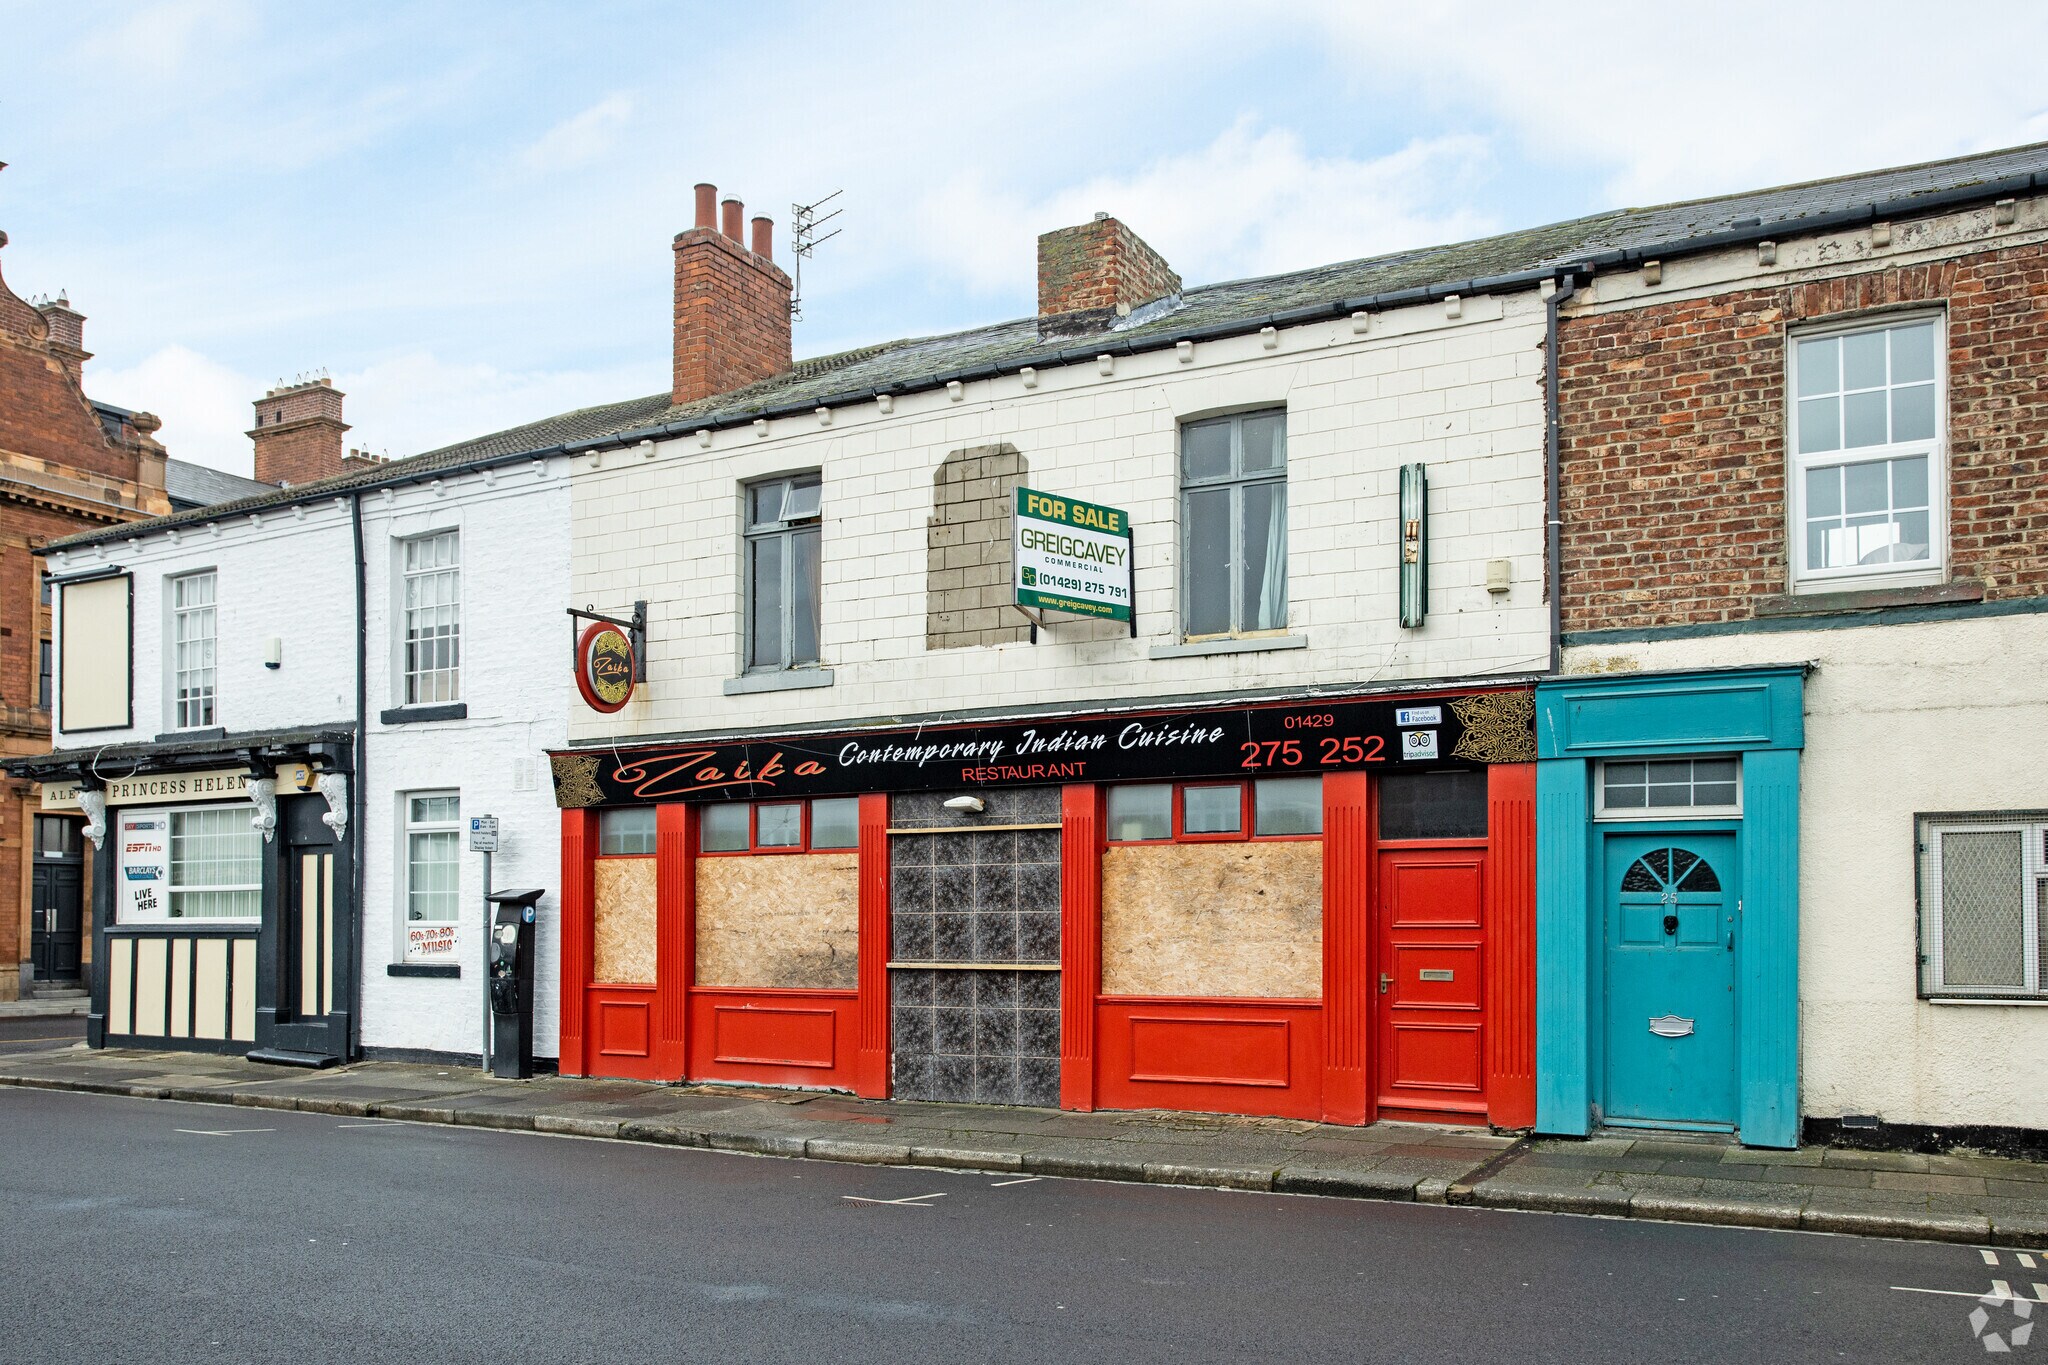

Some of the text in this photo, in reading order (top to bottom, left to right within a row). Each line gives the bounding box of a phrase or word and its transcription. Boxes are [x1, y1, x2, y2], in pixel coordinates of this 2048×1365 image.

[1028, 494, 1119, 532] FOR SALE
[1044, 556, 1104, 574] COMMERCIAL
[1039, 572, 1127, 599] (01429) 275 791
[1038, 595, 1113, 614] www.greigcavey.com
[593, 657, 629, 676] Zaika
[1284, 713, 1334, 729] 01429
[838, 722, 1225, 768] Contemporary Indian Cuisine
[1240, 735, 1386, 768] 275 252
[1403, 750, 1436, 758] tripadvisor
[612, 751, 827, 798] Zaika
[961, 761, 1087, 782] RESTAURANT
[50, 789, 81, 801] ALE
[112, 779, 186, 798] PRINCESS
[126, 843, 152, 853] ESPN
[128, 867, 156, 875] BARCLAYS
[134, 888, 152, 901] LIVE
[1661, 892, 1678, 904] 25
[137, 898, 157, 911] HERE
[421, 939, 452, 953] MUSIC
